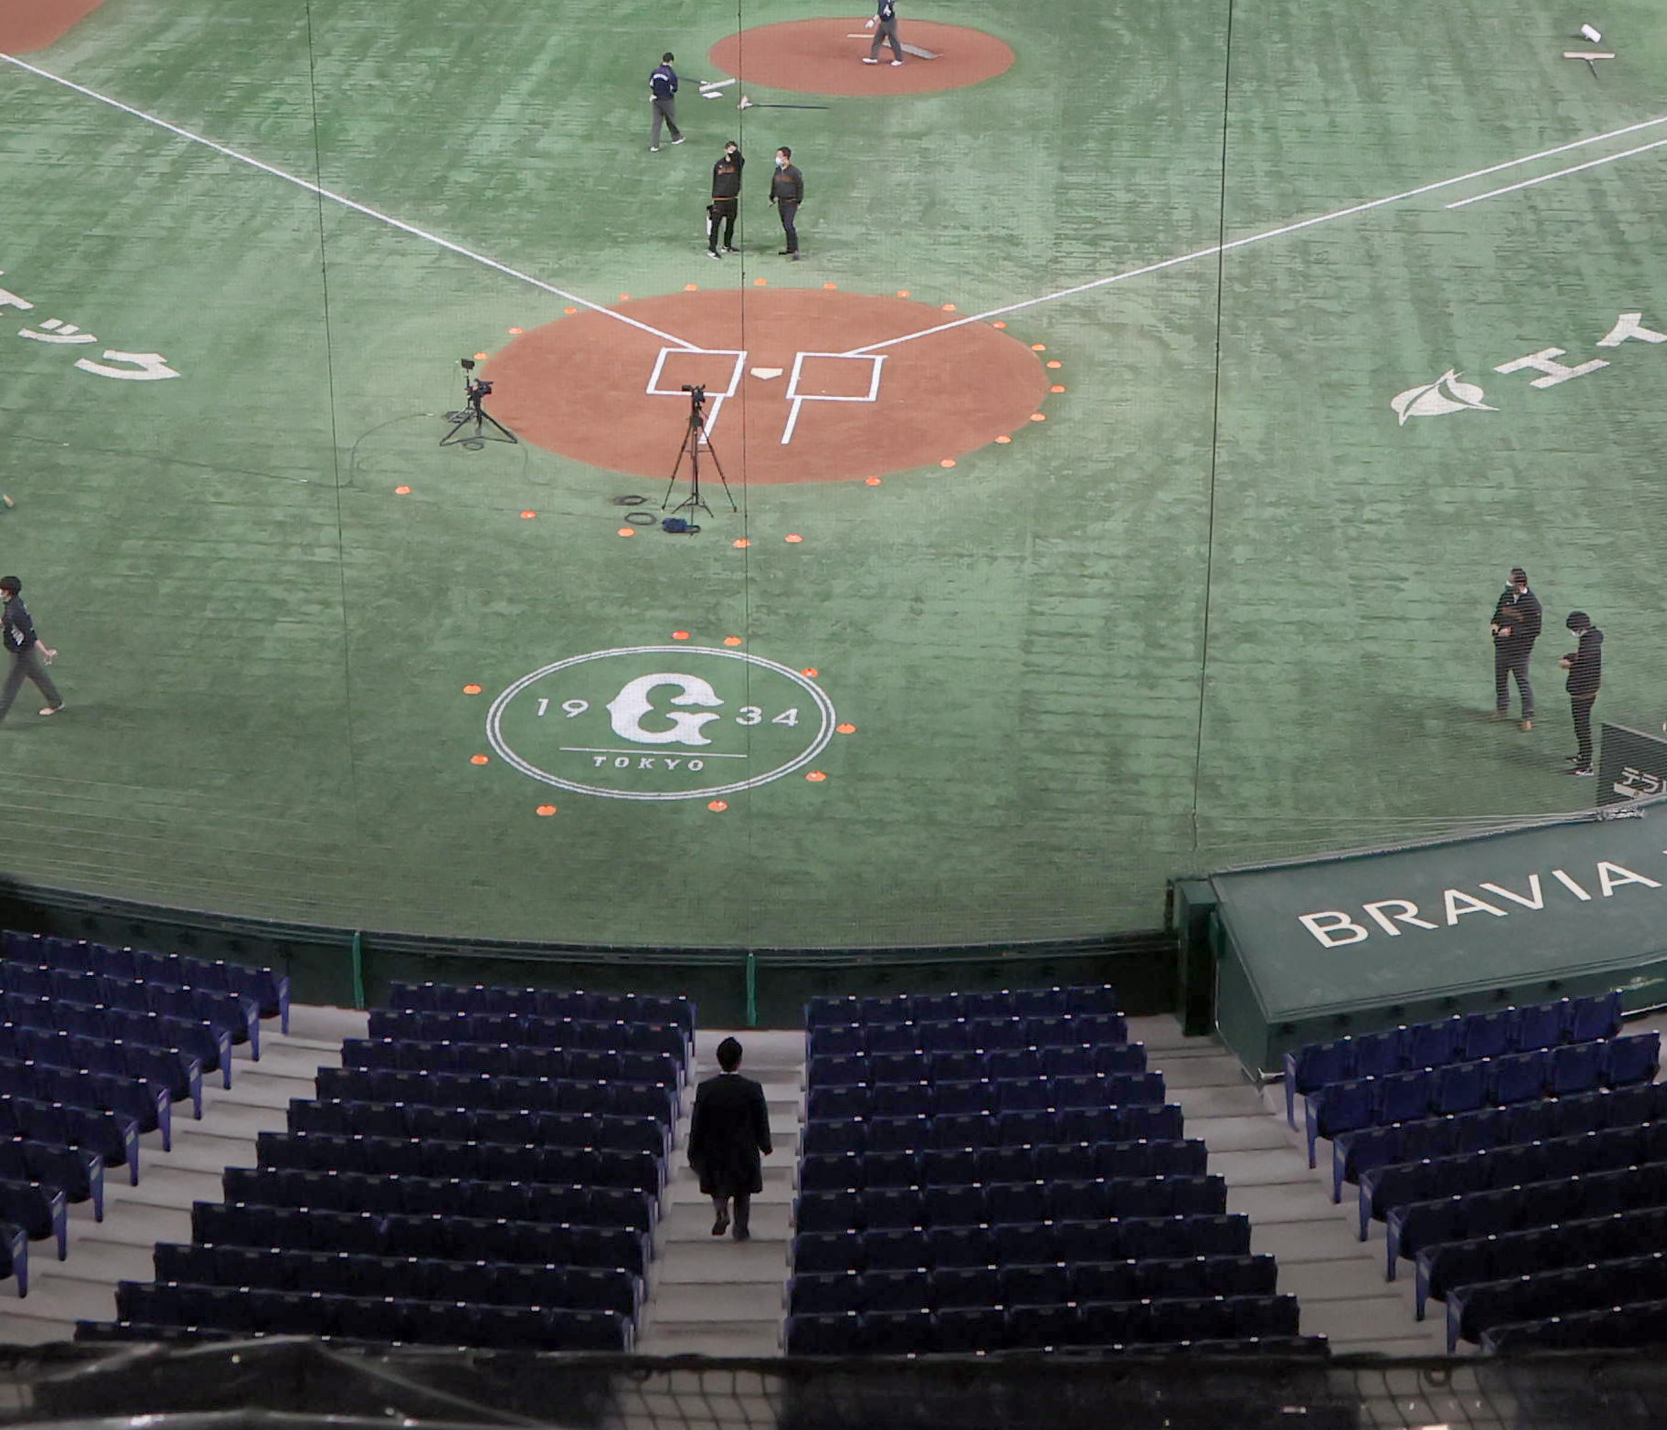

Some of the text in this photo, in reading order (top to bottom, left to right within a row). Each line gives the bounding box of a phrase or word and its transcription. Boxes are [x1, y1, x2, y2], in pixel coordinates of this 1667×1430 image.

[605, 672, 724, 746] G
[593, 754, 705, 772] TOKYO
[1298, 861, 1663, 949] BRAVIA
